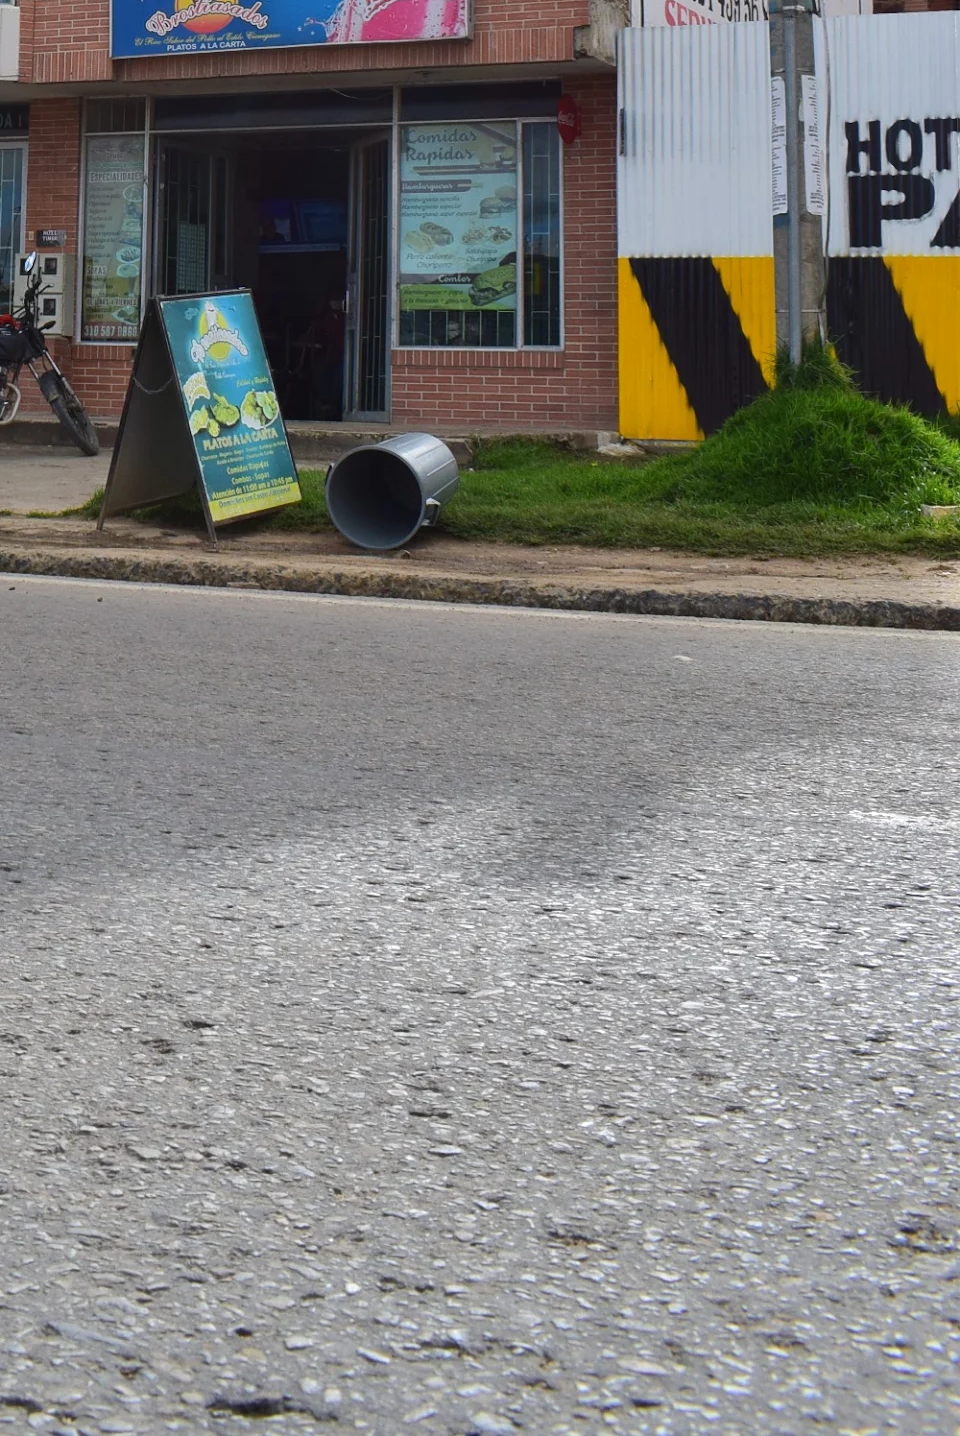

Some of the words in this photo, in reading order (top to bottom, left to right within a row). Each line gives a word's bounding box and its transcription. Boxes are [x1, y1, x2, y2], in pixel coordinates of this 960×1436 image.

[166, 43, 197, 52] PLATOS
[207, 42, 218, 50] LA
[219, 39, 247, 49] CARTA
[406, 127, 478, 144] Comidas
[405, 146, 474, 165] Rapidas
[84, 324, 99, 337] 310
